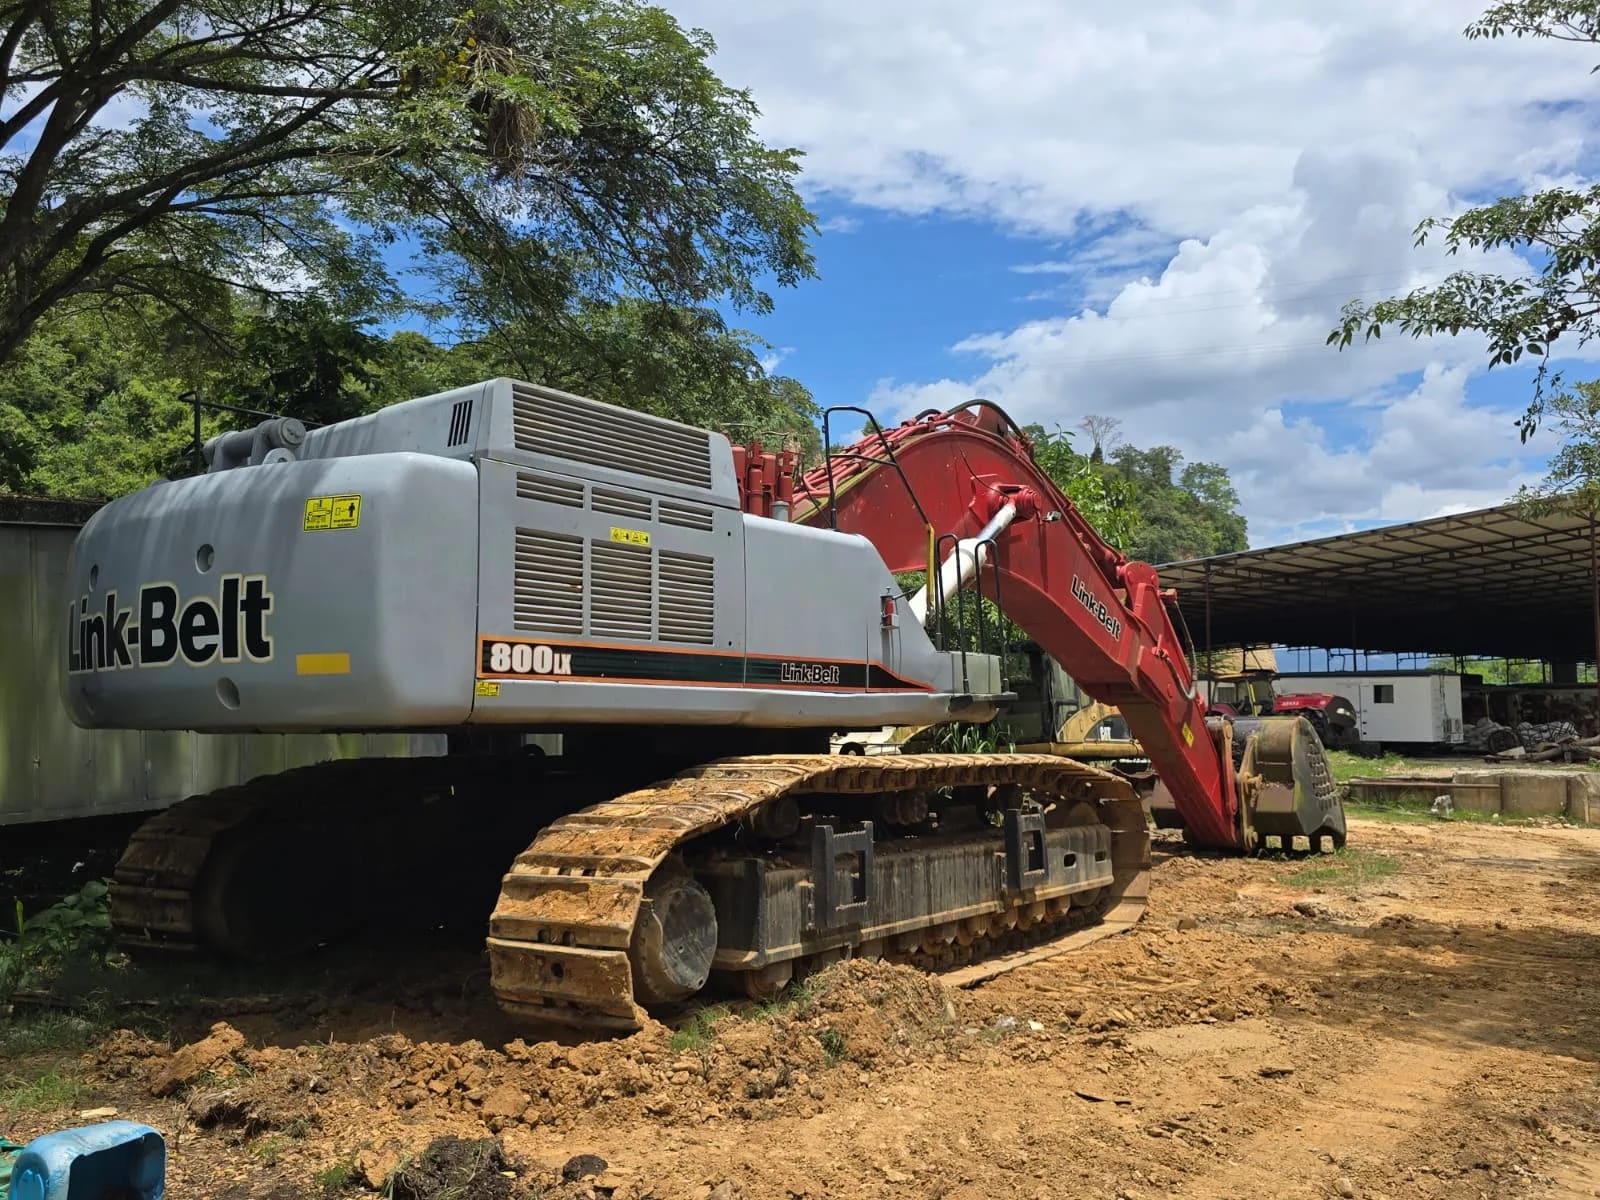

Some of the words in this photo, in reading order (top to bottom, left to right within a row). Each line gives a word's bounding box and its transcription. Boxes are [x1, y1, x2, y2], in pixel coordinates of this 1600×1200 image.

[69, 574, 273, 675] Link-Belt
[1071, 574, 1121, 641] Link-Belt
[781, 662, 840, 684] Link-Belt
